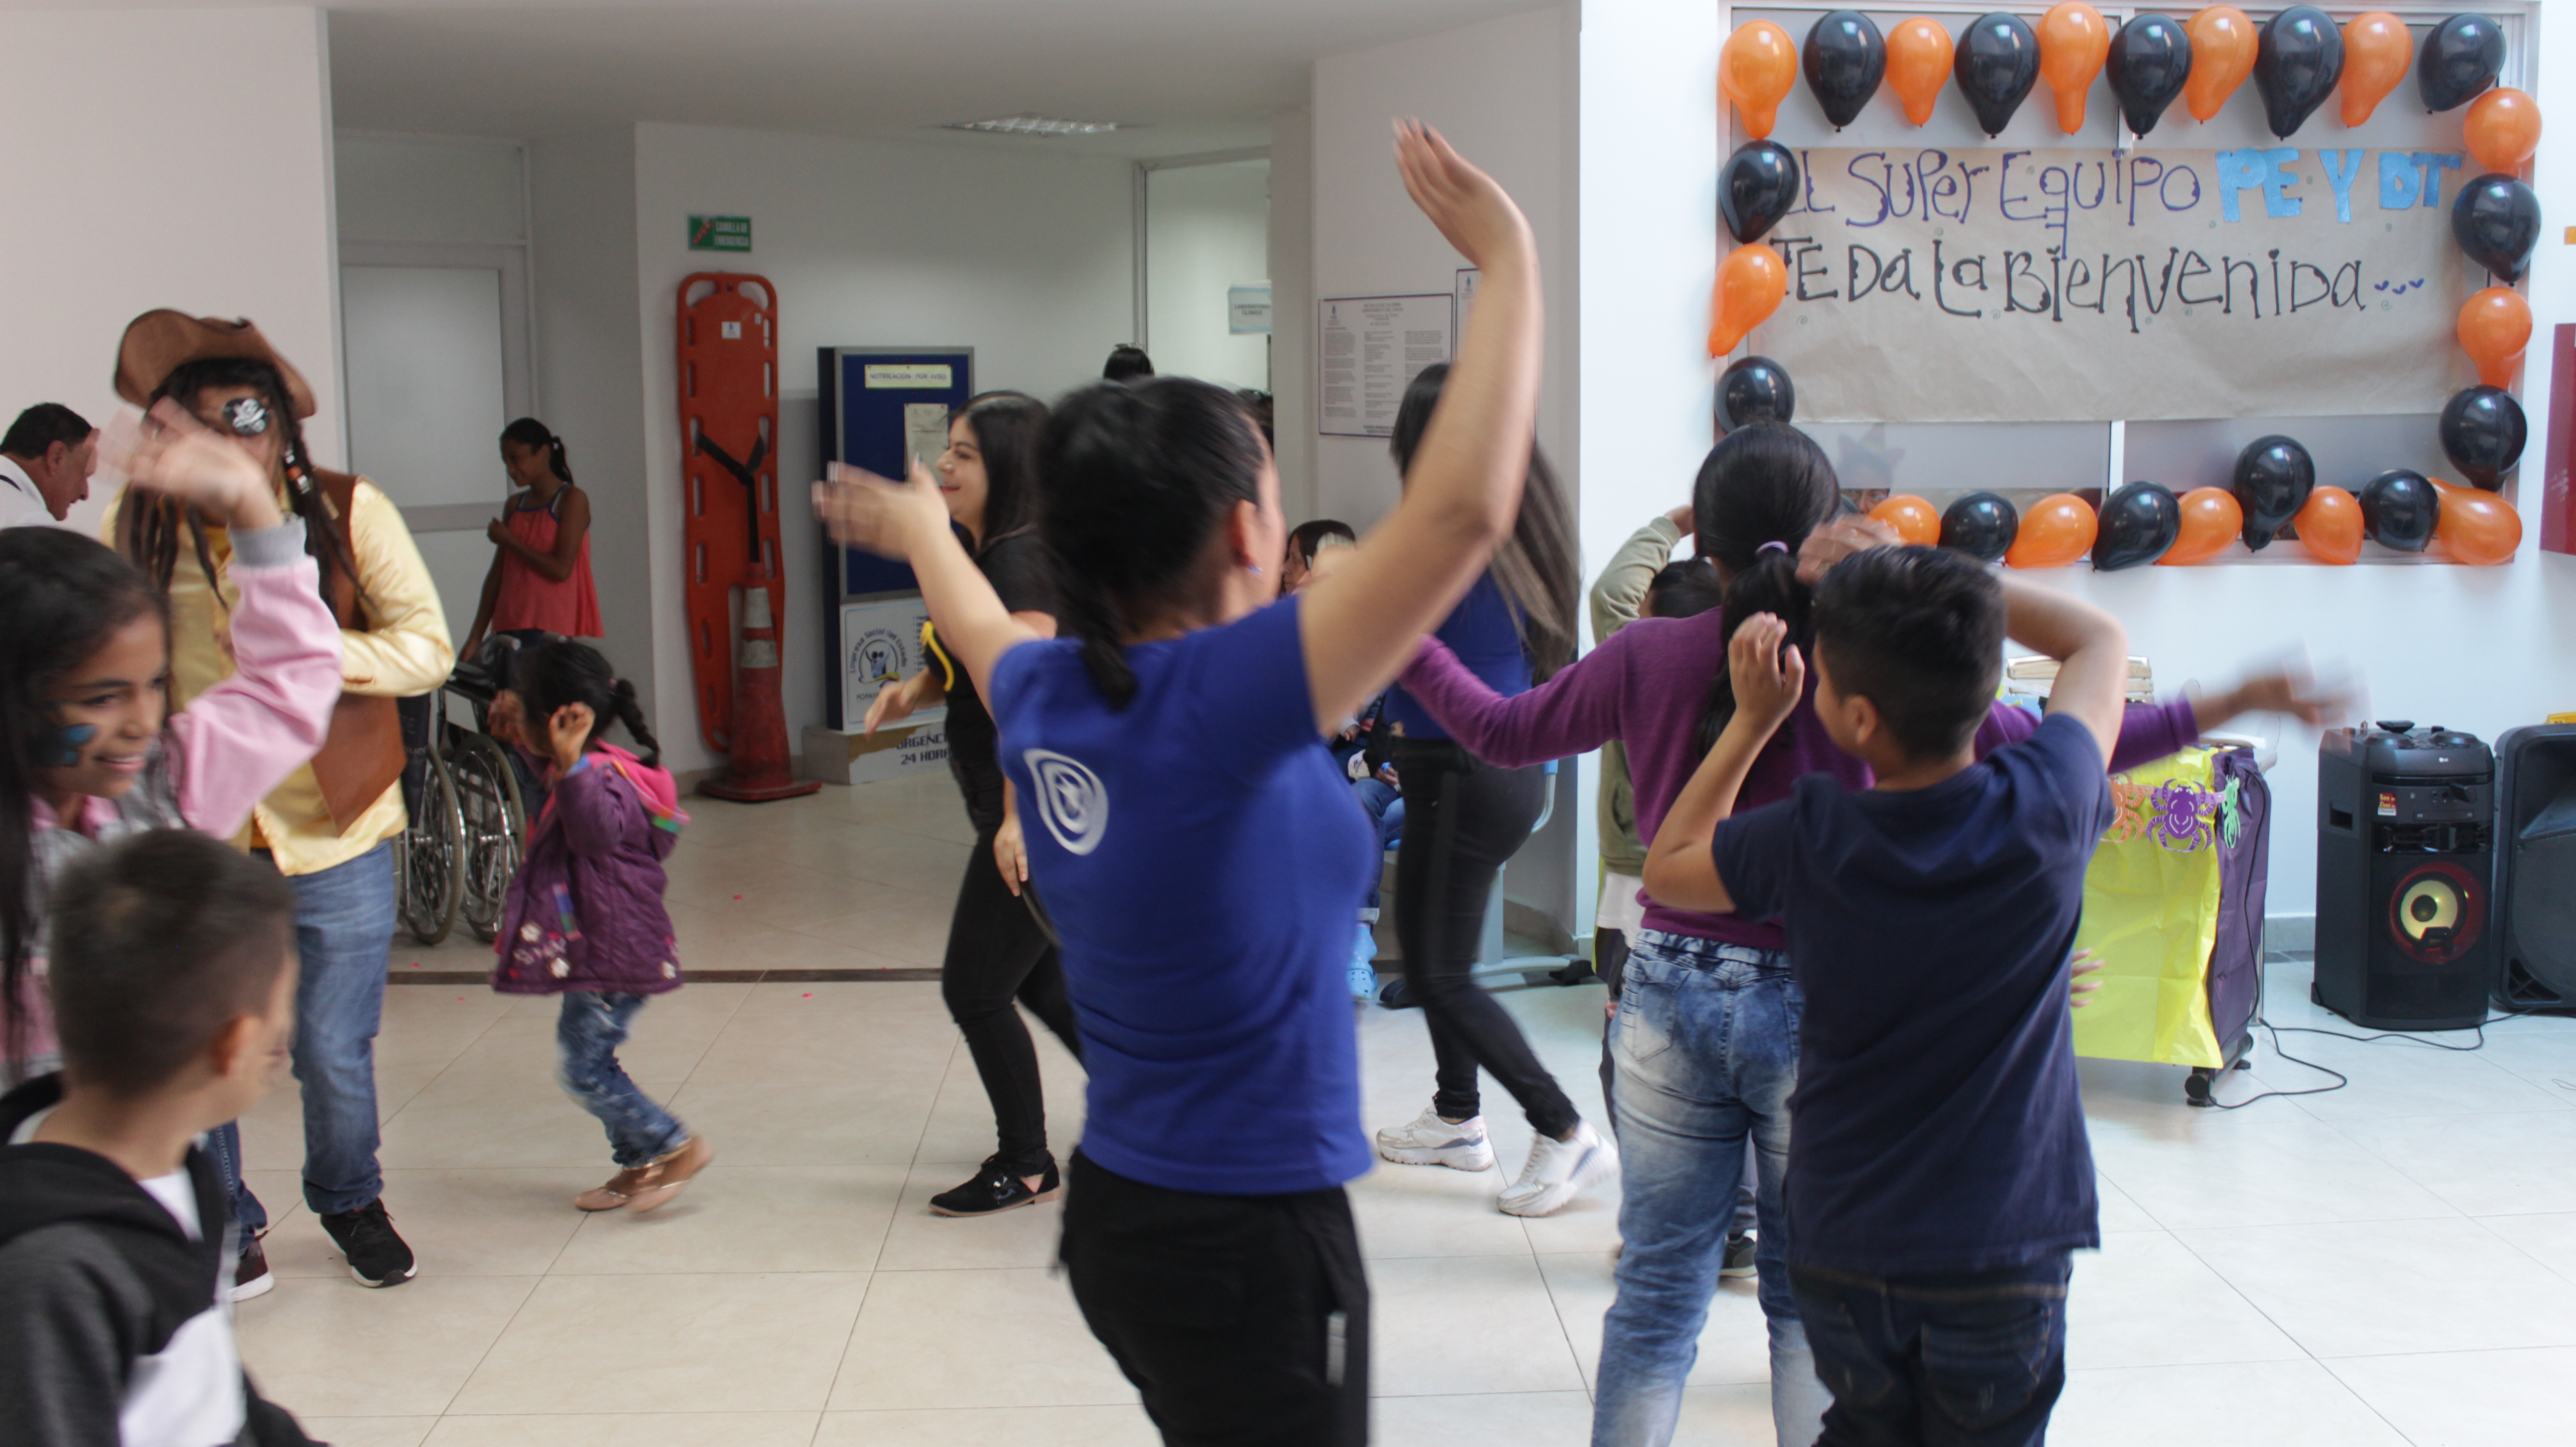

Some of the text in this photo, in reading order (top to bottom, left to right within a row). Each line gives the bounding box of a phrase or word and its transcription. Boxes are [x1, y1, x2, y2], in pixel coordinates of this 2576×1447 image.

[1785, 150, 1836, 215] L
[2215, 146, 2303, 223] PE
[2317, 148, 2365, 224] Y
[2378, 151, 2463, 210] DT
[864, 627, 886, 639] Social
[886, 629, 897, 640] del
[895, 638, 907, 667] Estado
[900, 753, 916, 765] 24
